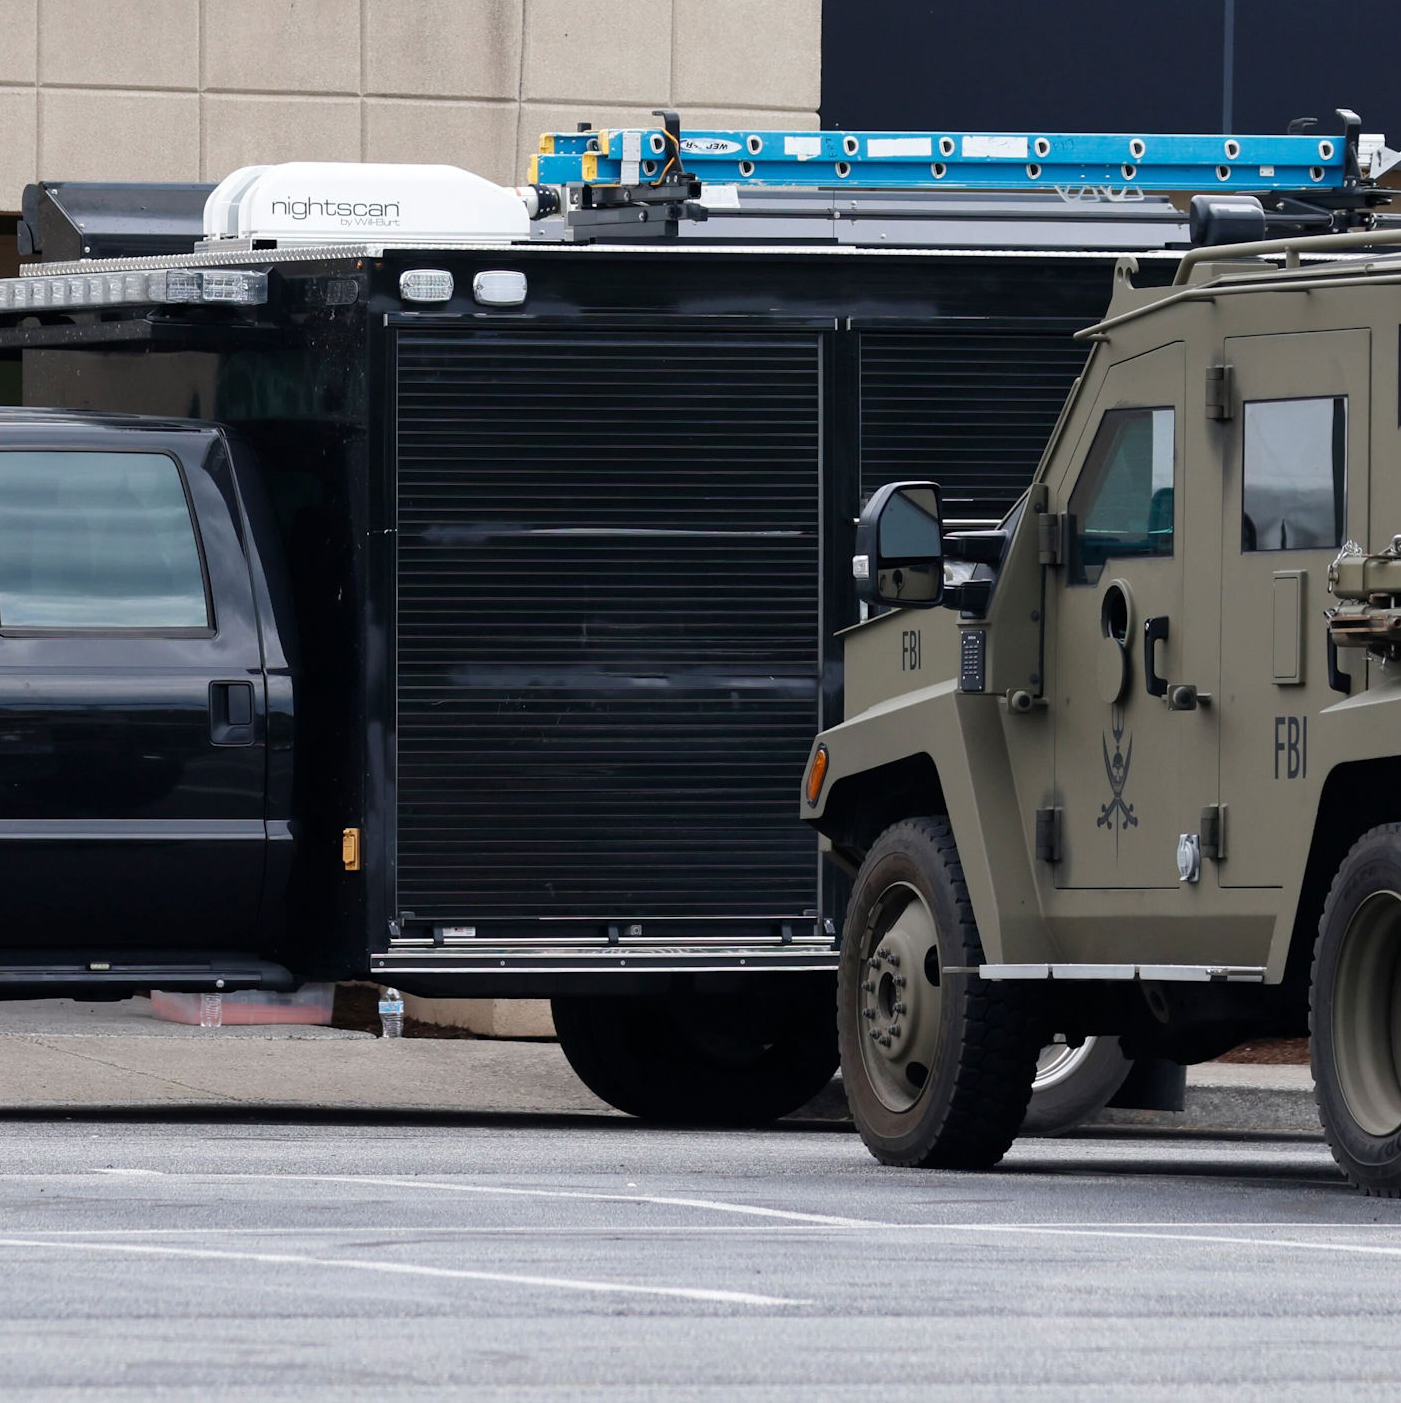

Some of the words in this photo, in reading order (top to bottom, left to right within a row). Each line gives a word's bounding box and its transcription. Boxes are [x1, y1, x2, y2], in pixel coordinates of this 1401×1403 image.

[271, 196, 400, 220] nightscan
[340, 217, 353, 227] by
[354, 217, 401, 227] Will-Burt
[902, 629, 922, 671] FBI
[1274, 715, 1308, 780] FBI
